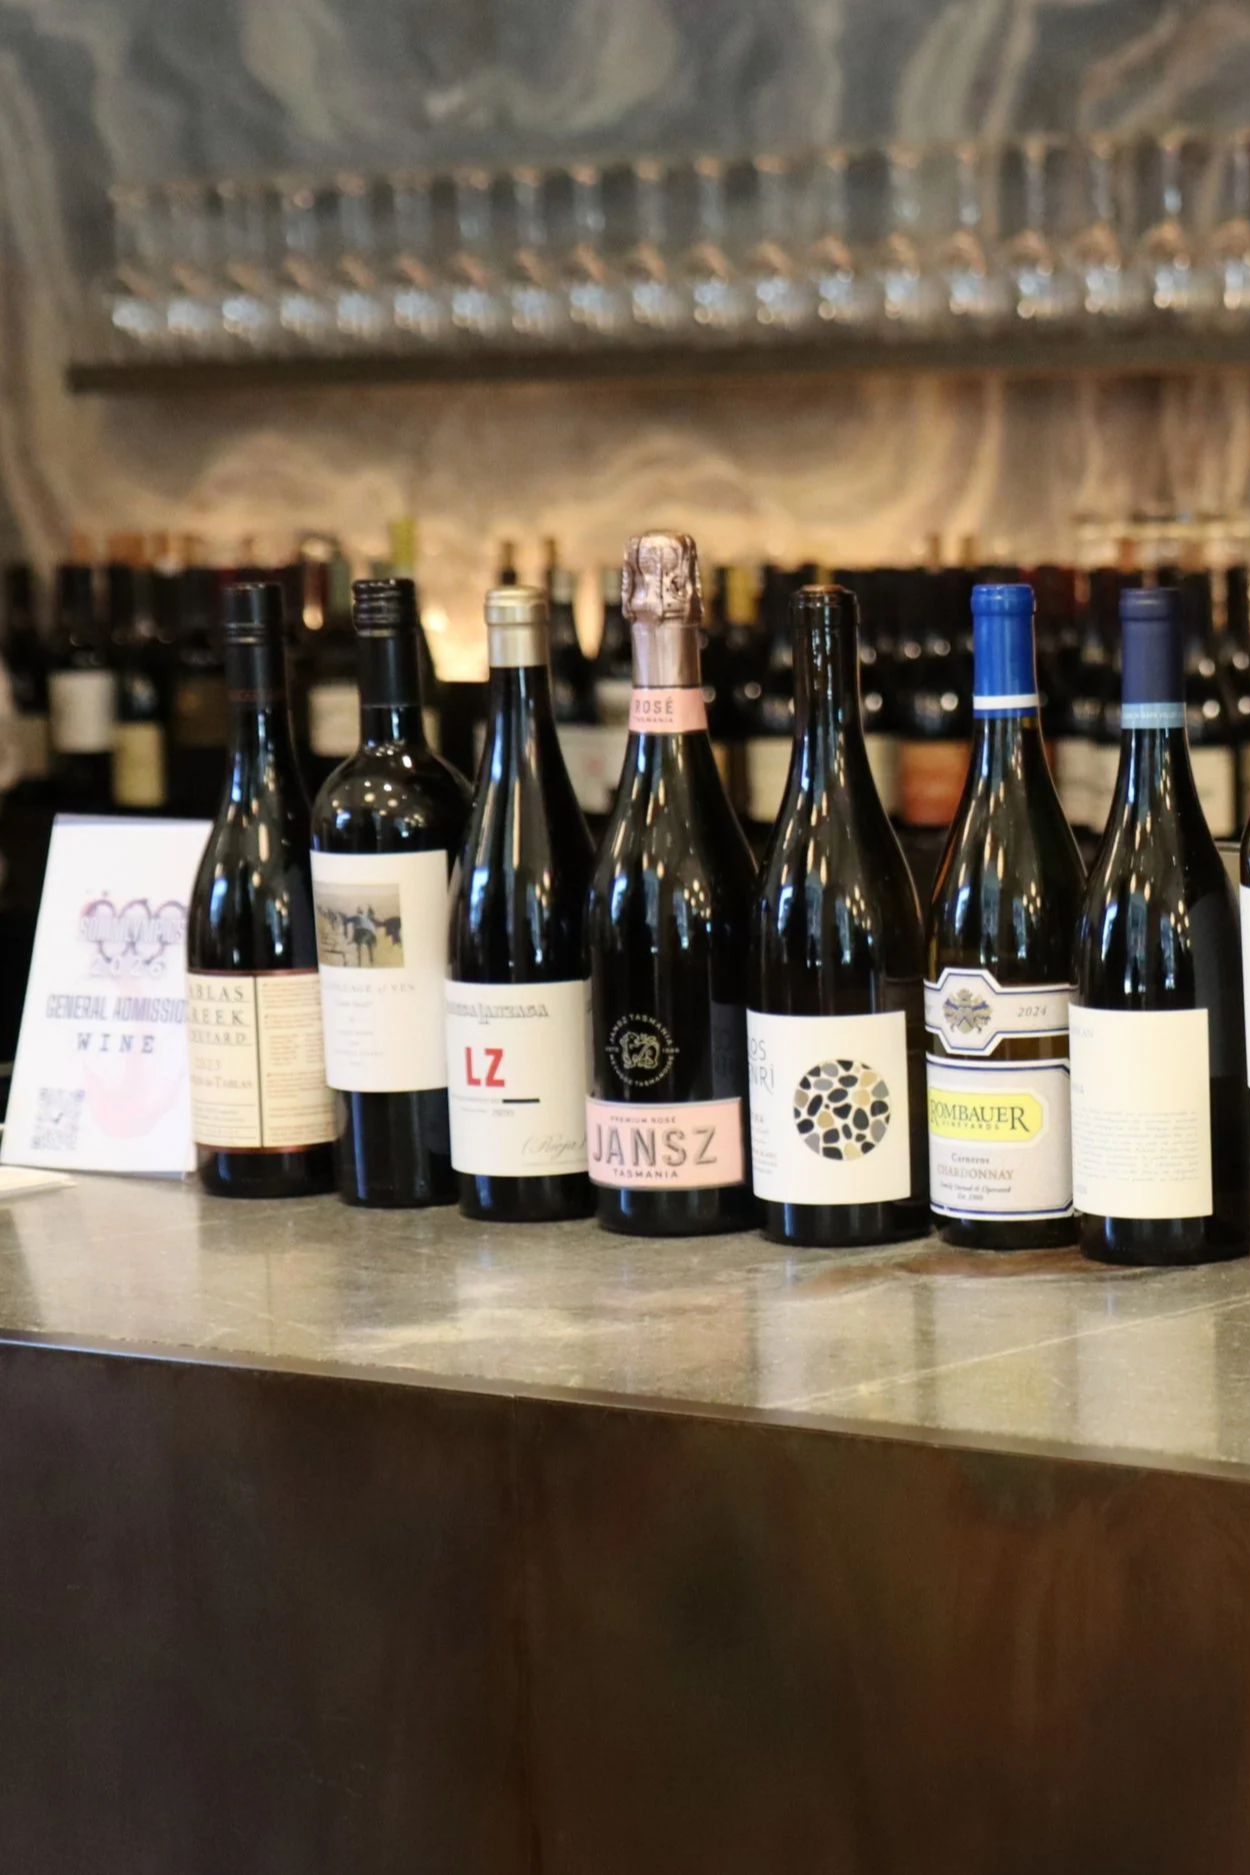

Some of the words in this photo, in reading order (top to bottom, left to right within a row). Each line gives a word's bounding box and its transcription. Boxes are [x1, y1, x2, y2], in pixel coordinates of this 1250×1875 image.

[635, 697, 673, 715] ROSÉ
[45, 993, 107, 1021] GENERAL
[112, 997, 188, 1024] ADMISSIO
[189, 1007, 245, 1025] REEK
[1017, 1006, 1048, 1018] 2024
[629, 1014, 673, 1046] TASMANIA
[76, 1032, 156, 1054] WINE
[464, 1046, 506, 1088] LZ
[610, 1115, 648, 1124] PREMIUM
[929, 1099, 1030, 1133] ROMBAUER
[593, 1123, 718, 1168] JANSZ
[612, 1168, 679, 1179] TASMANIA
